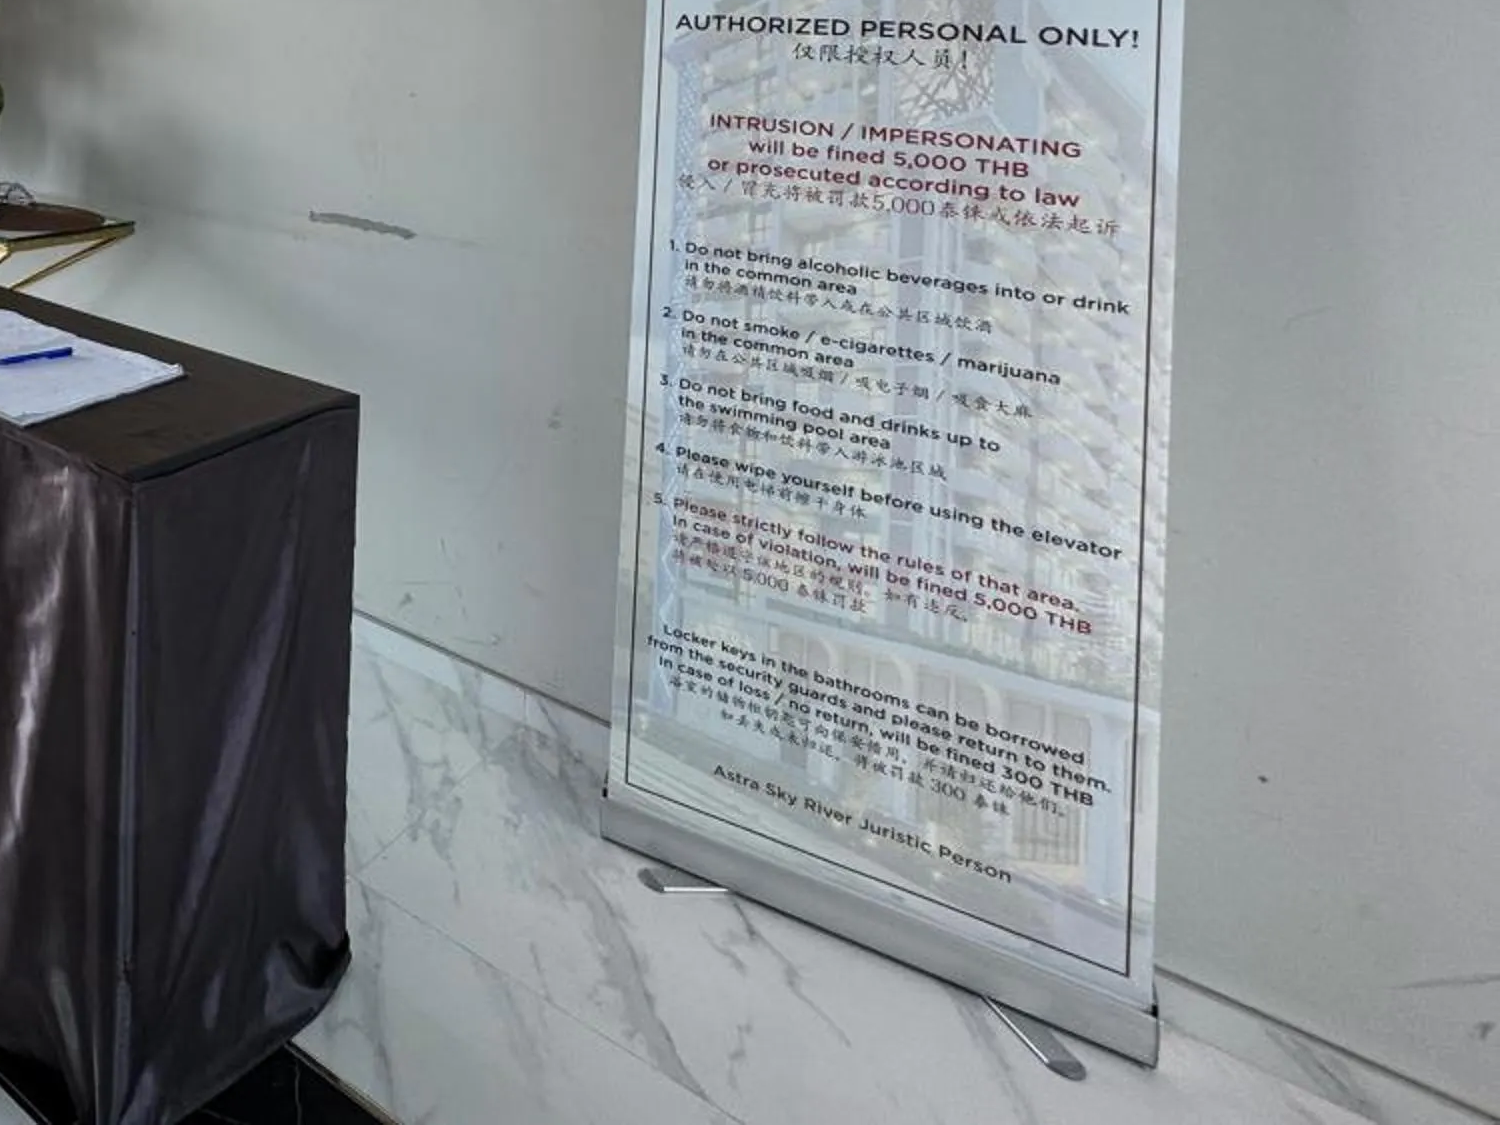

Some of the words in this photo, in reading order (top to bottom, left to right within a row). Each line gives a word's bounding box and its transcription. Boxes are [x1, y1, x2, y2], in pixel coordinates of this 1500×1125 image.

[676, 14, 850, 36] AUTHORIZED
[861, 20, 1027, 44] PERSONAL
[1039, 26, 1139, 49] ONLY!
[710, 113, 833, 137] INTRUSION
[841, 123, 855, 141] /
[861, 126, 1081, 158] IMPERSONATING
[749, 140, 785, 156] will
[792, 143, 819, 159] be
[827, 145, 885, 165] fined
[893, 152, 966, 173] 5,000
[975, 159, 1029, 178] THB
[708, 159, 729, 172] or
[736, 161, 860, 186] prosecuted
[868, 174, 989, 202] according
[999, 186, 1025, 202] to
[1035, 188, 1080, 207] law
[669, 239, 679, 252] 1.
[685, 242, 708, 255] Do
[713, 247, 741, 260] not
[747, 251, 793, 269] bring
[797, 258, 881, 280] alcoholic
[887, 269, 988, 295] beverages
[995, 283, 1035, 302] into
[1042, 292, 1066, 306] or
[1072, 296, 1131, 315] drink
[685, 259, 698, 272] in
[704, 262, 731, 276] the
[736, 269, 812, 288] common
[817, 281, 857, 295] area
[682, 327, 696, 340] in
[701, 331, 728, 345] the
[734, 337, 809, 359] common
[814, 352, 854, 367] area
[683, 310, 705, 324] Do
[711, 315, 738, 329] not
[744, 321, 800, 340] smoke
[805, 330, 815, 343] /
[820, 335, 935, 363] e-cigarettes
[940, 352, 951, 366] /
[958, 356, 1061, 386] marijuana
[660, 374, 672, 387] 3.
[679, 378, 703, 392] Do
[707, 383, 736, 398] not
[741, 390, 787, 412] bring
[793, 400, 834, 420] food
[839, 411, 875, 428] and
[881, 418, 940, 440] drinks
[947, 432, 973, 448] up
[979, 437, 1001, 452] to
[679, 395, 704, 409] the
[709, 404, 797, 432] swimming
[803, 421, 844, 441] pool
[850, 434, 890, 450] area
[676, 447, 729, 468] Please
[735, 461, 776, 479] wipe
[782, 474, 853, 499] yourself
[861, 488, 923, 513] before
[930, 505, 984, 530] using
[990, 518, 1025, 537] the
[1032, 529, 1122, 560] elevator
[673, 514, 687, 528] In
[693, 522, 730, 539] case
[736, 533, 754, 547] of
[759, 540, 841, 572] violation,
[848, 563, 879, 580] will
[886, 570, 910, 586] be
[916, 578, 967, 602] fined
[974, 593, 1037, 620] 5,000
[1045, 611, 1092, 635] THB
[674, 498, 727, 522] Please
[733, 511, 792, 539] strictly
[798, 529, 853, 553] follow
[860, 545, 891, 563] the
[897, 555, 944, 576] rules
[951, 568, 972, 583] of
[978, 574, 1020, 597] that
[1027, 588, 1080, 613] area.
[647, 635, 683, 656] from
[688, 649, 714, 665] the
[719, 658, 782, 688] security
[788, 681, 847, 709] guards
[852, 700, 886, 720] and
[892, 714, 952, 741] please
[957, 735, 1017, 762] return
[1024, 753, 1045, 772] to
[1051, 763, 1112, 793] them.
[659, 655, 672, 669] In
[677, 664, 713, 682] case
[717, 674, 733, 688] of
[739, 679, 771, 702] loss
[774, 693, 784, 705] /
[789, 699, 811, 714] no
[815, 707, 873, 736] return,
[879, 727, 911, 746] will
[916, 738, 940, 755] be
[946, 747, 995, 774] fined
[1001, 765, 1043, 790] 300
[1049, 781, 1094, 807] THB
[664, 625, 716, 649] Locker
[721, 641, 756, 663] keys
[761, 652, 776, 668] in
[781, 661, 809, 678] the
[813, 670, 910, 710] bathrooms
[915, 702, 949, 722] can
[955, 712, 980, 731] be
[985, 723, 1085, 765] borrowed
[714, 765, 759, 791] Astra
[765, 782, 798, 806] Sky
[804, 797, 853, 825] River
[858, 817, 933, 855] Juristic
[938, 843, 1012, 884] Person
